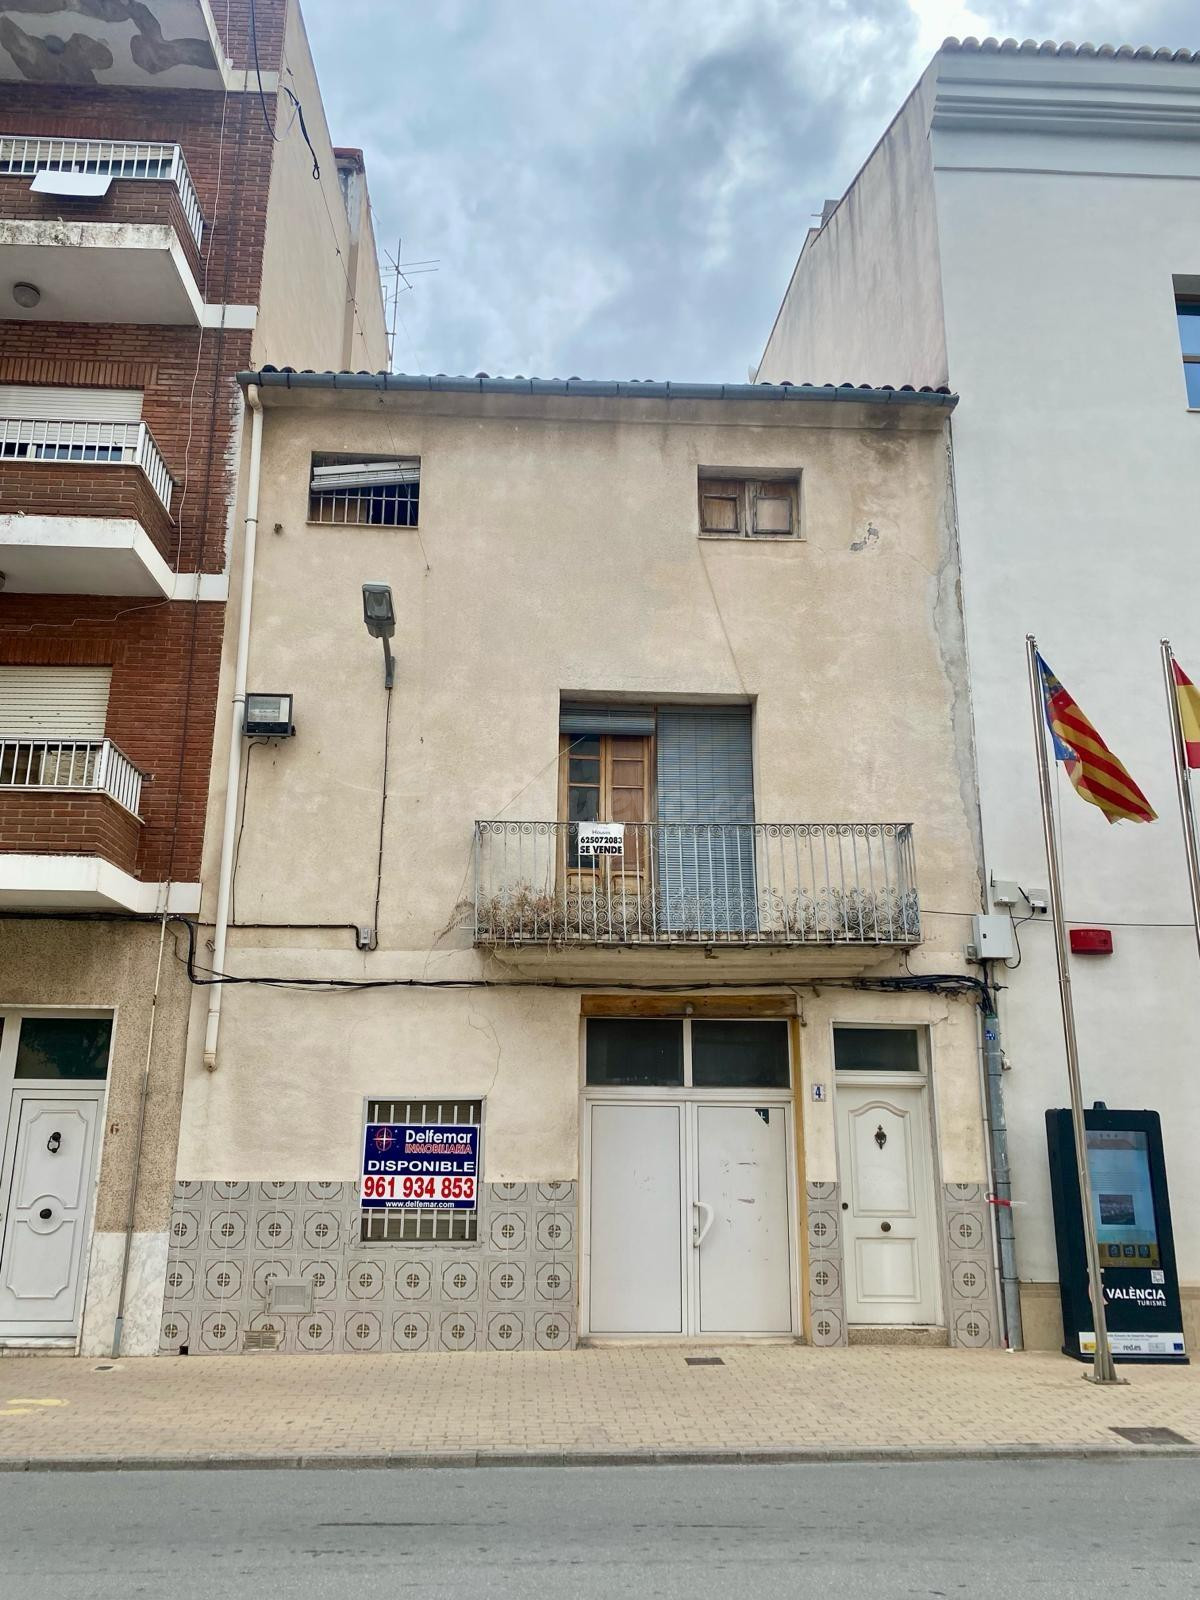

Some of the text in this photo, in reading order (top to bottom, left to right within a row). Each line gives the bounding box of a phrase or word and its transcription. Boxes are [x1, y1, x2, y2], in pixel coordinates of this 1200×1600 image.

[580, 836, 623, 844] 625072083
[580, 846, 622, 854] SE VENDE
[815, 1086, 822, 1099] 4
[405, 1130, 472, 1143] Delfemar
[404, 1144, 473, 1154] INMOBILIARIA
[368, 1160, 475, 1172] DISPONIBLE
[364, 1176, 474, 1199] 961 934 853
[1106, 1286, 1166, 1300] VALÈNCIA
